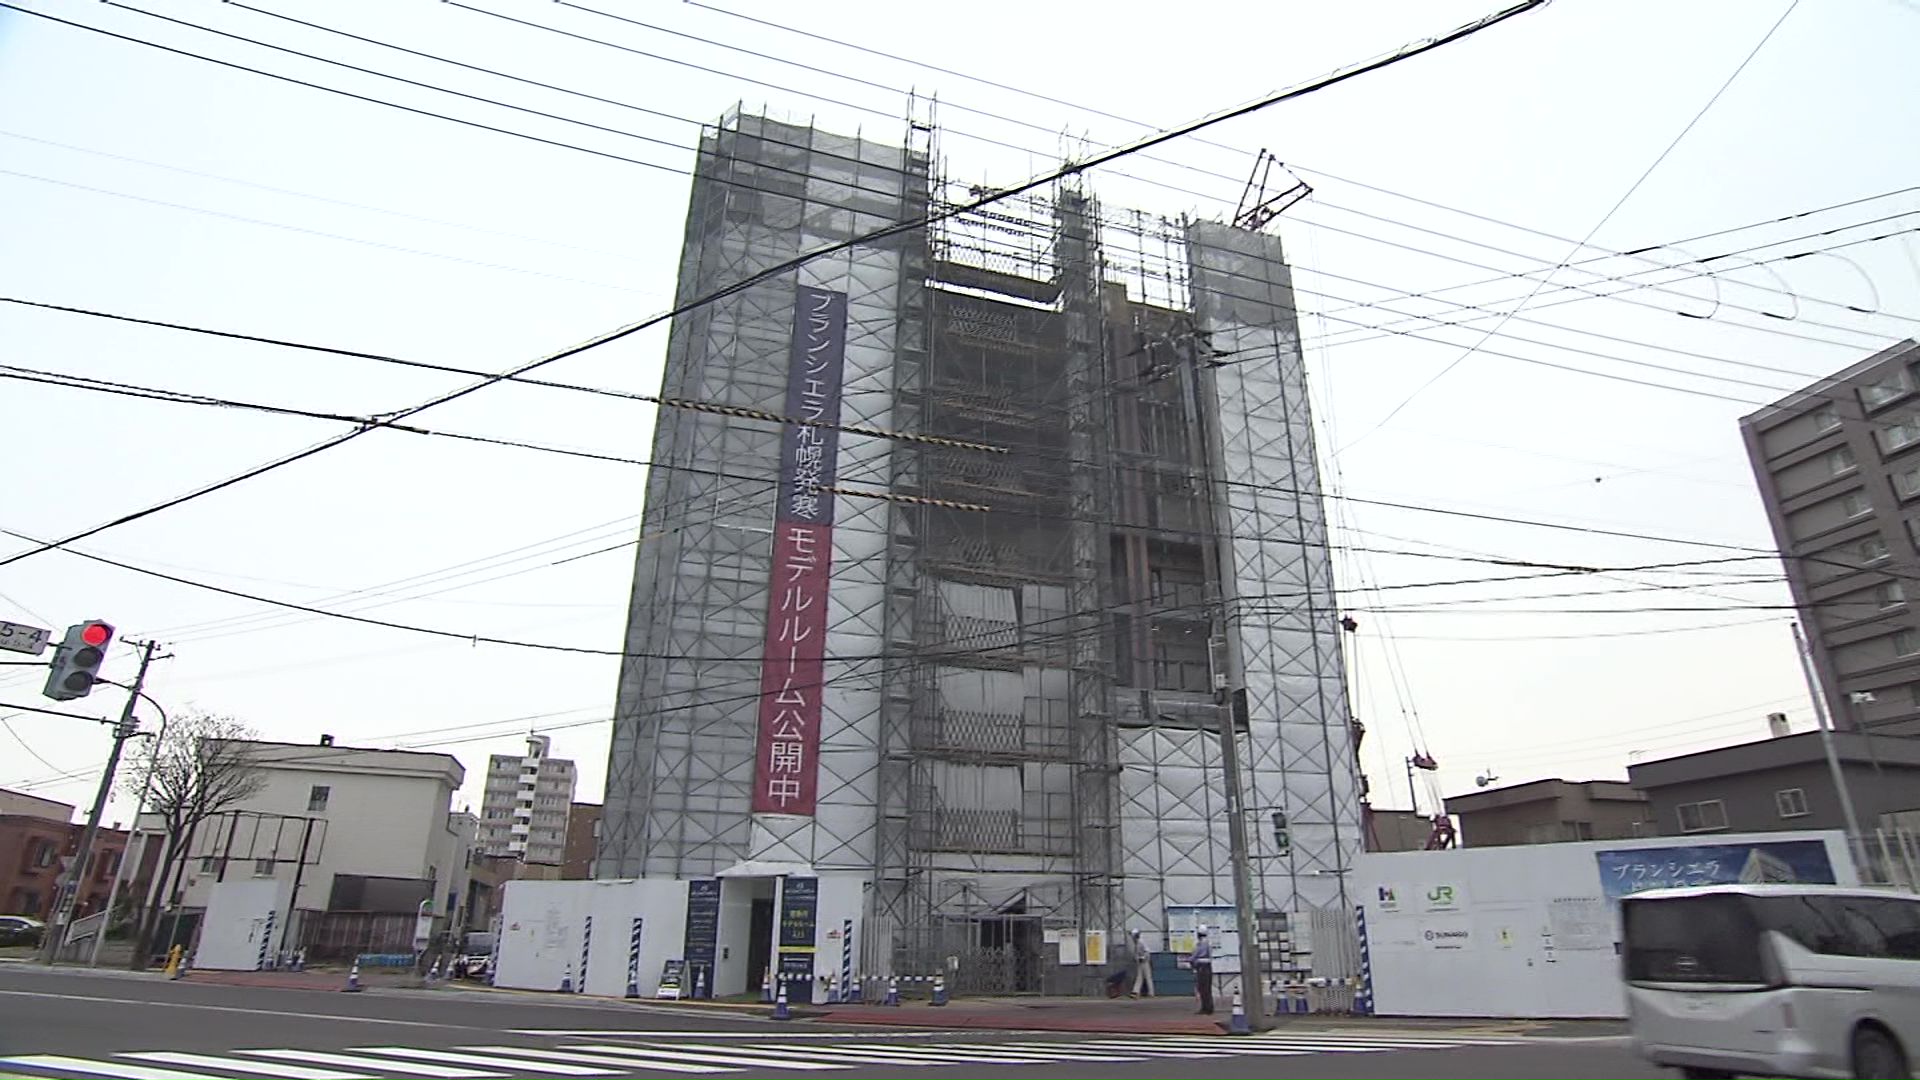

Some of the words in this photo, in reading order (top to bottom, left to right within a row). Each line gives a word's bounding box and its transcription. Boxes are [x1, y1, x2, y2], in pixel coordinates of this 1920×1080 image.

[768, 528, 816, 807] モデルルーム公開中
[1427, 886, 1453, 901] JR
